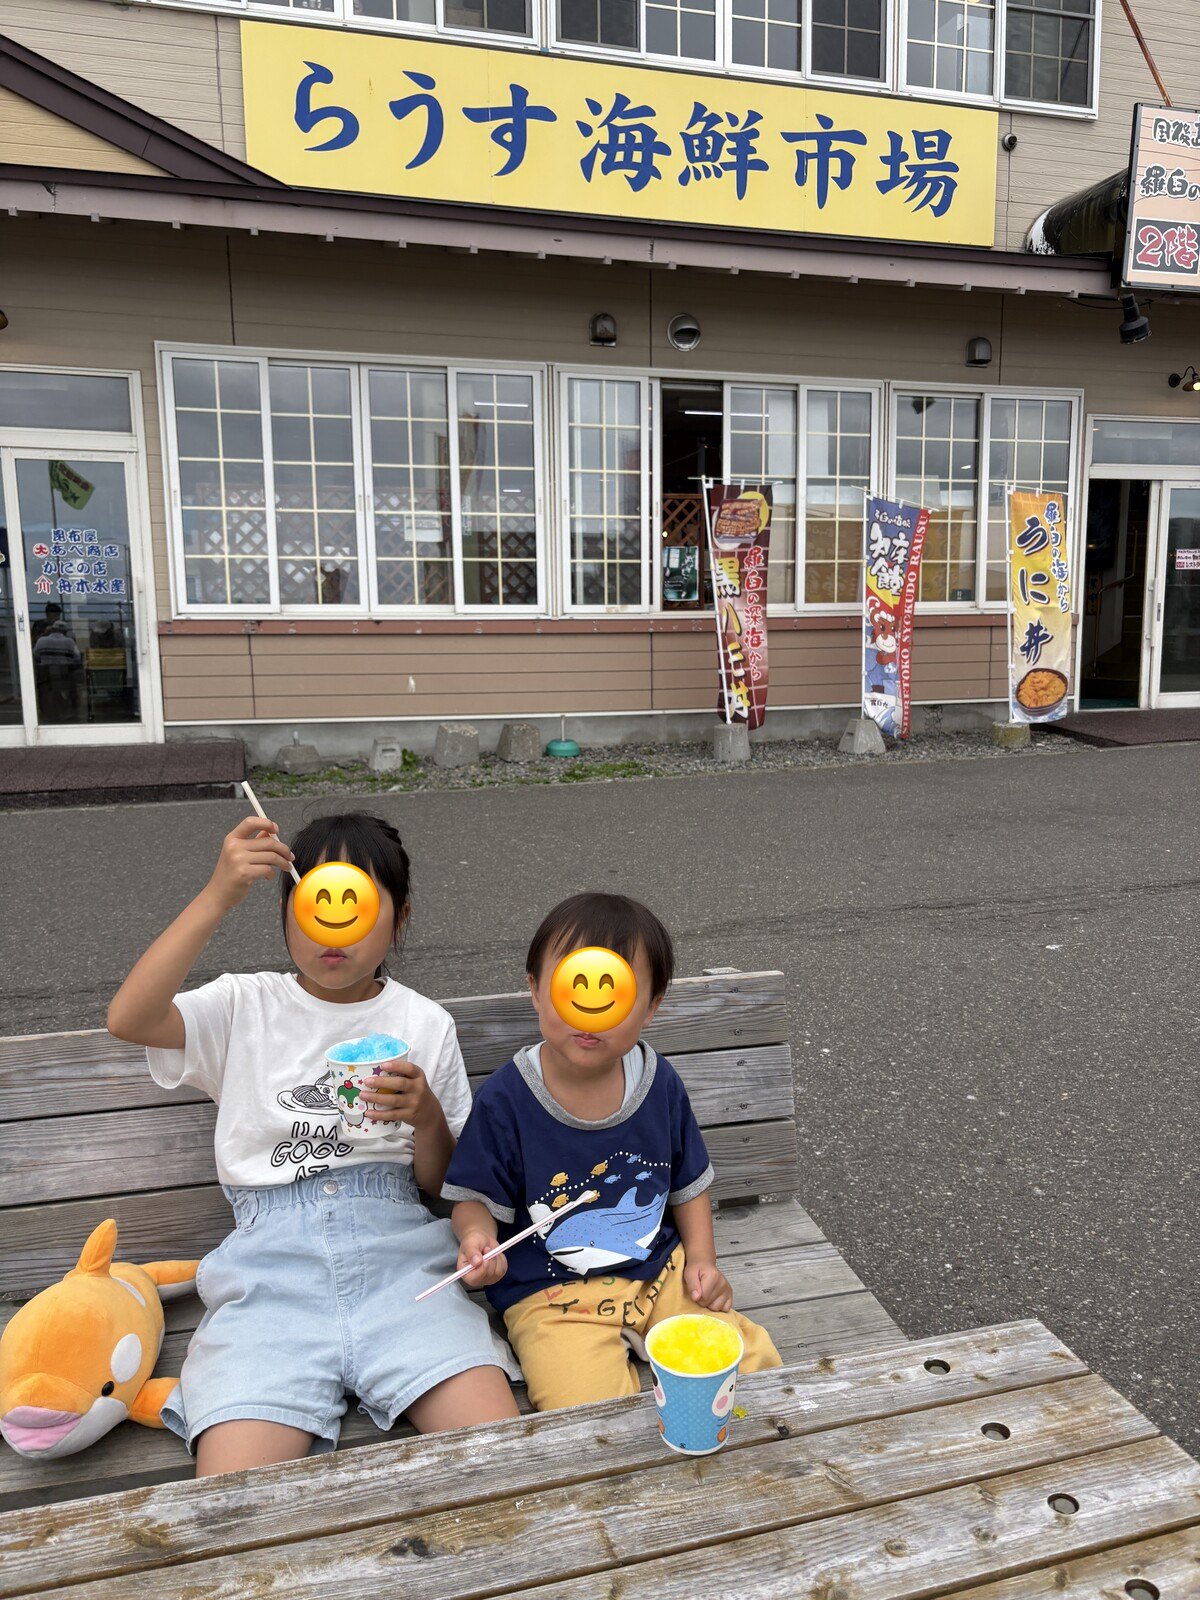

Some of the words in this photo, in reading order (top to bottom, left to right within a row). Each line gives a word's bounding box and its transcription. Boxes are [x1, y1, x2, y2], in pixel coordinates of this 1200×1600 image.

[294, 60, 960, 219] らうす海鮮市場
[1137, 225, 1199, 268] 2階
[909, 515, 928, 566] RAUSU
[43, 561, 107, 576] かにの店
[743, 545, 765, 682] 羅臼の深海から
[292, 1121, 338, 1140] I'M
[271, 1140, 354, 1167] GOOD
